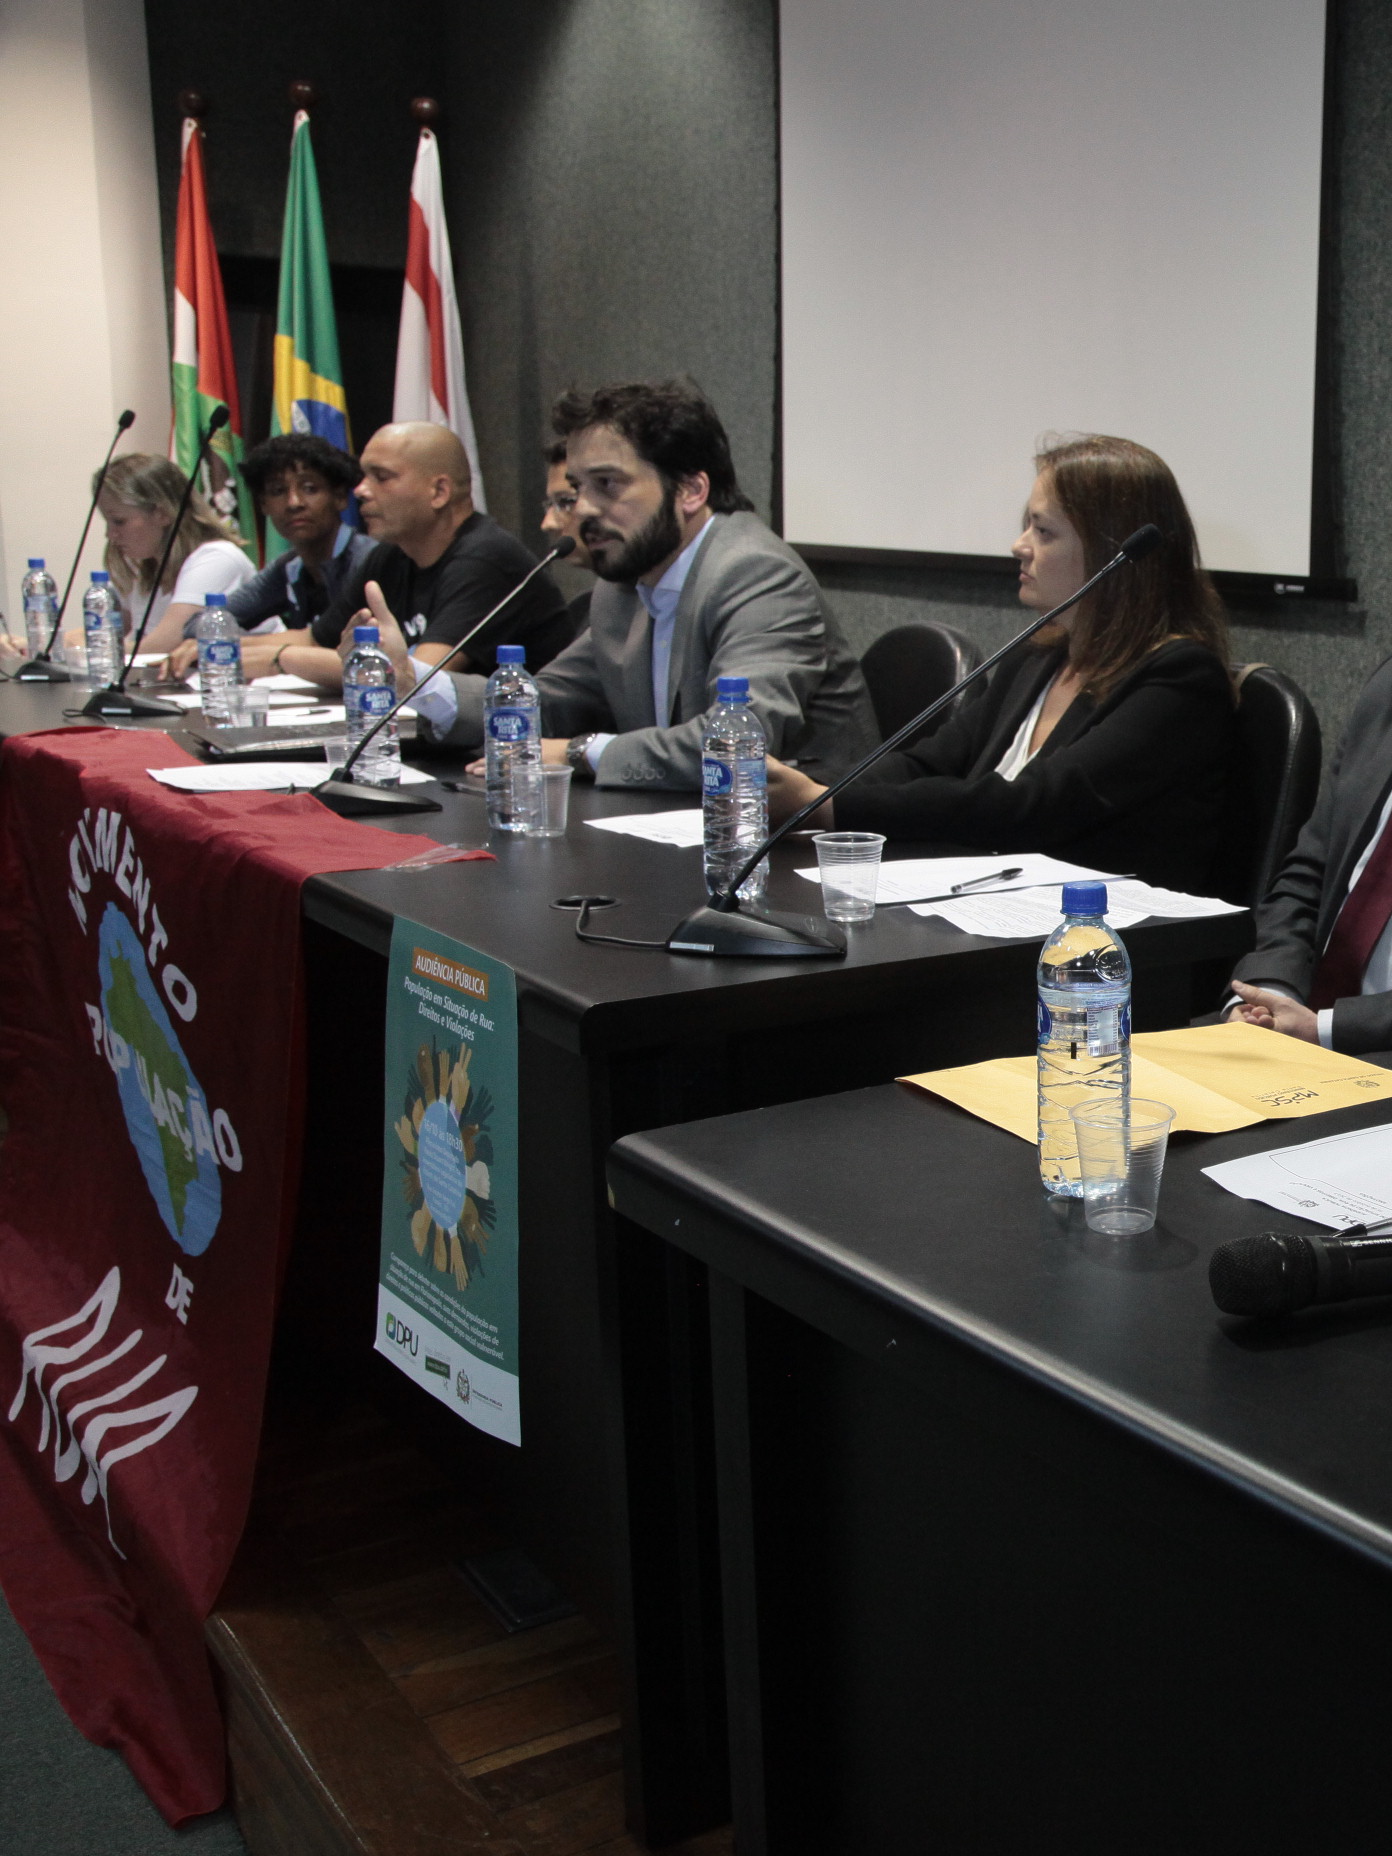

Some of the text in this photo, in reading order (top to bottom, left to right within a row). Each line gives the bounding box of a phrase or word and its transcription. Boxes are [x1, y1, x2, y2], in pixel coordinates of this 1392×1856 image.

[366, 690, 392, 702] SANTA
[493, 716, 522, 726] SANTA
[703, 765, 723, 778] NTA
[415, 955, 485, 996] AUDIÊNCIA PÚBLICA
[404, 976, 495, 1032] População em Situação de Rua:
[418, 1002, 440, 1024] Direitos
[446, 1015, 475, 1041] Violações
[165, 1263, 194, 1325] DE
[396, 1320, 418, 1357] DPU
